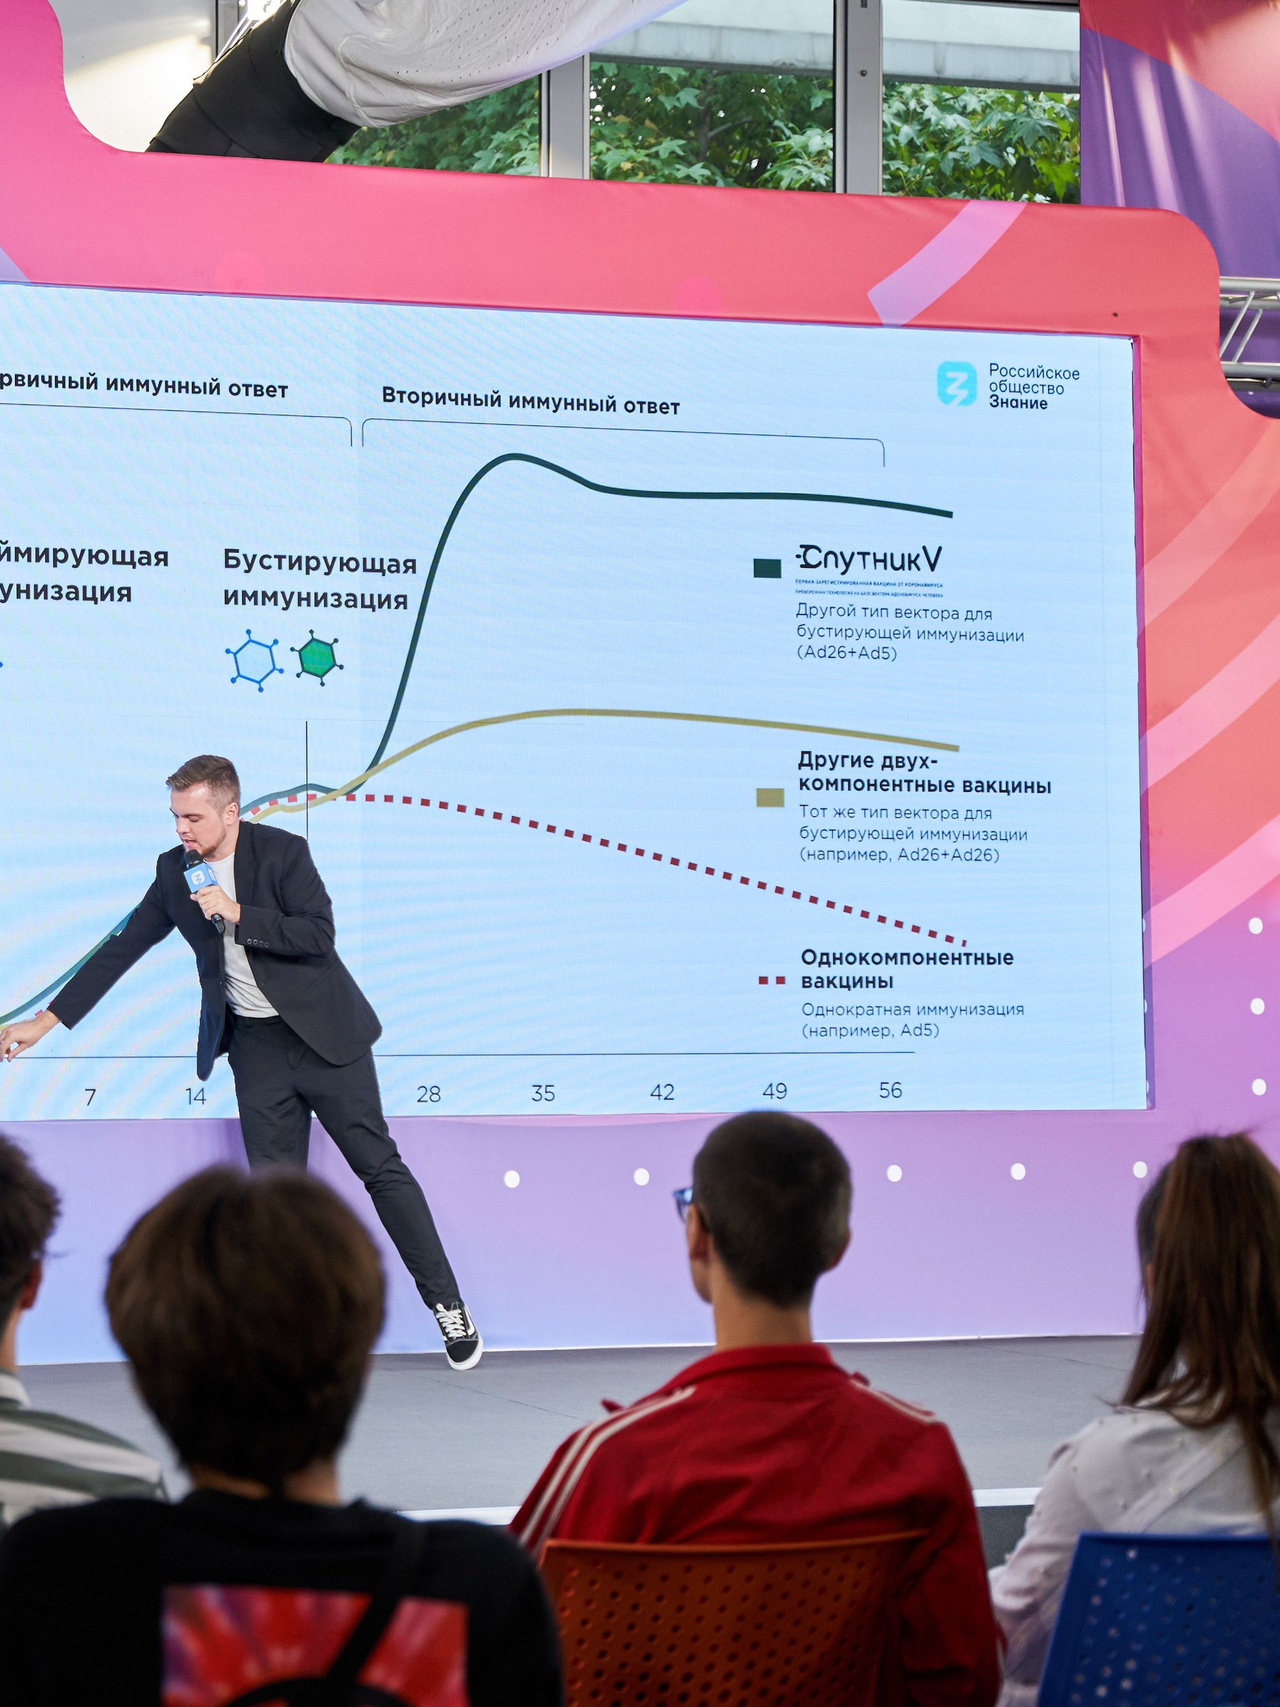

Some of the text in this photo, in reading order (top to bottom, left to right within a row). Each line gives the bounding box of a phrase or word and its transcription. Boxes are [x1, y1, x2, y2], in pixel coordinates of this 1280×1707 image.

[989, 363, 1081, 381] Российское
[106, 377, 221, 397] иммунный
[228, 382, 289, 399] ответ
[989, 380, 1066, 397] общество
[382, 385, 681, 416] Вторичный иммунный ответ
[989, 393, 1048, 410] Знание
[224, 548, 417, 577] Бустирующая
[223, 589, 408, 613] иммунизация
[795, 602, 993, 623] Другой тип вектора для
[796, 623, 1025, 644] бустирующей иммунизации
[796, 645, 898, 662] (Ad26+Ad5)
[797, 750, 938, 773] Другие двух-
[799, 777, 1052, 797] компонентные вакцины
[799, 803, 992, 823] Тот же тип вектора для
[799, 825, 1028, 844] бустирующей иммунизации
[799, 846, 1000, 864] (например, Ad26+Ad26)
[801, 948, 1015, 968] Однокомпонентные
[801, 975, 894, 992] вакцины
[801, 1002, 1025, 1019] Однократная иммунизация
[802, 1022, 940, 1040] (например, Ad5)
[84, 1088, 97, 1107] 7
[185, 1087, 207, 1106] 14
[416, 1085, 442, 1103] 28
[531, 1084, 556, 1102] 35
[649, 1083, 675, 1101] 42
[762, 1082, 788, 1100] 49
[879, 1081, 903, 1099] 56
